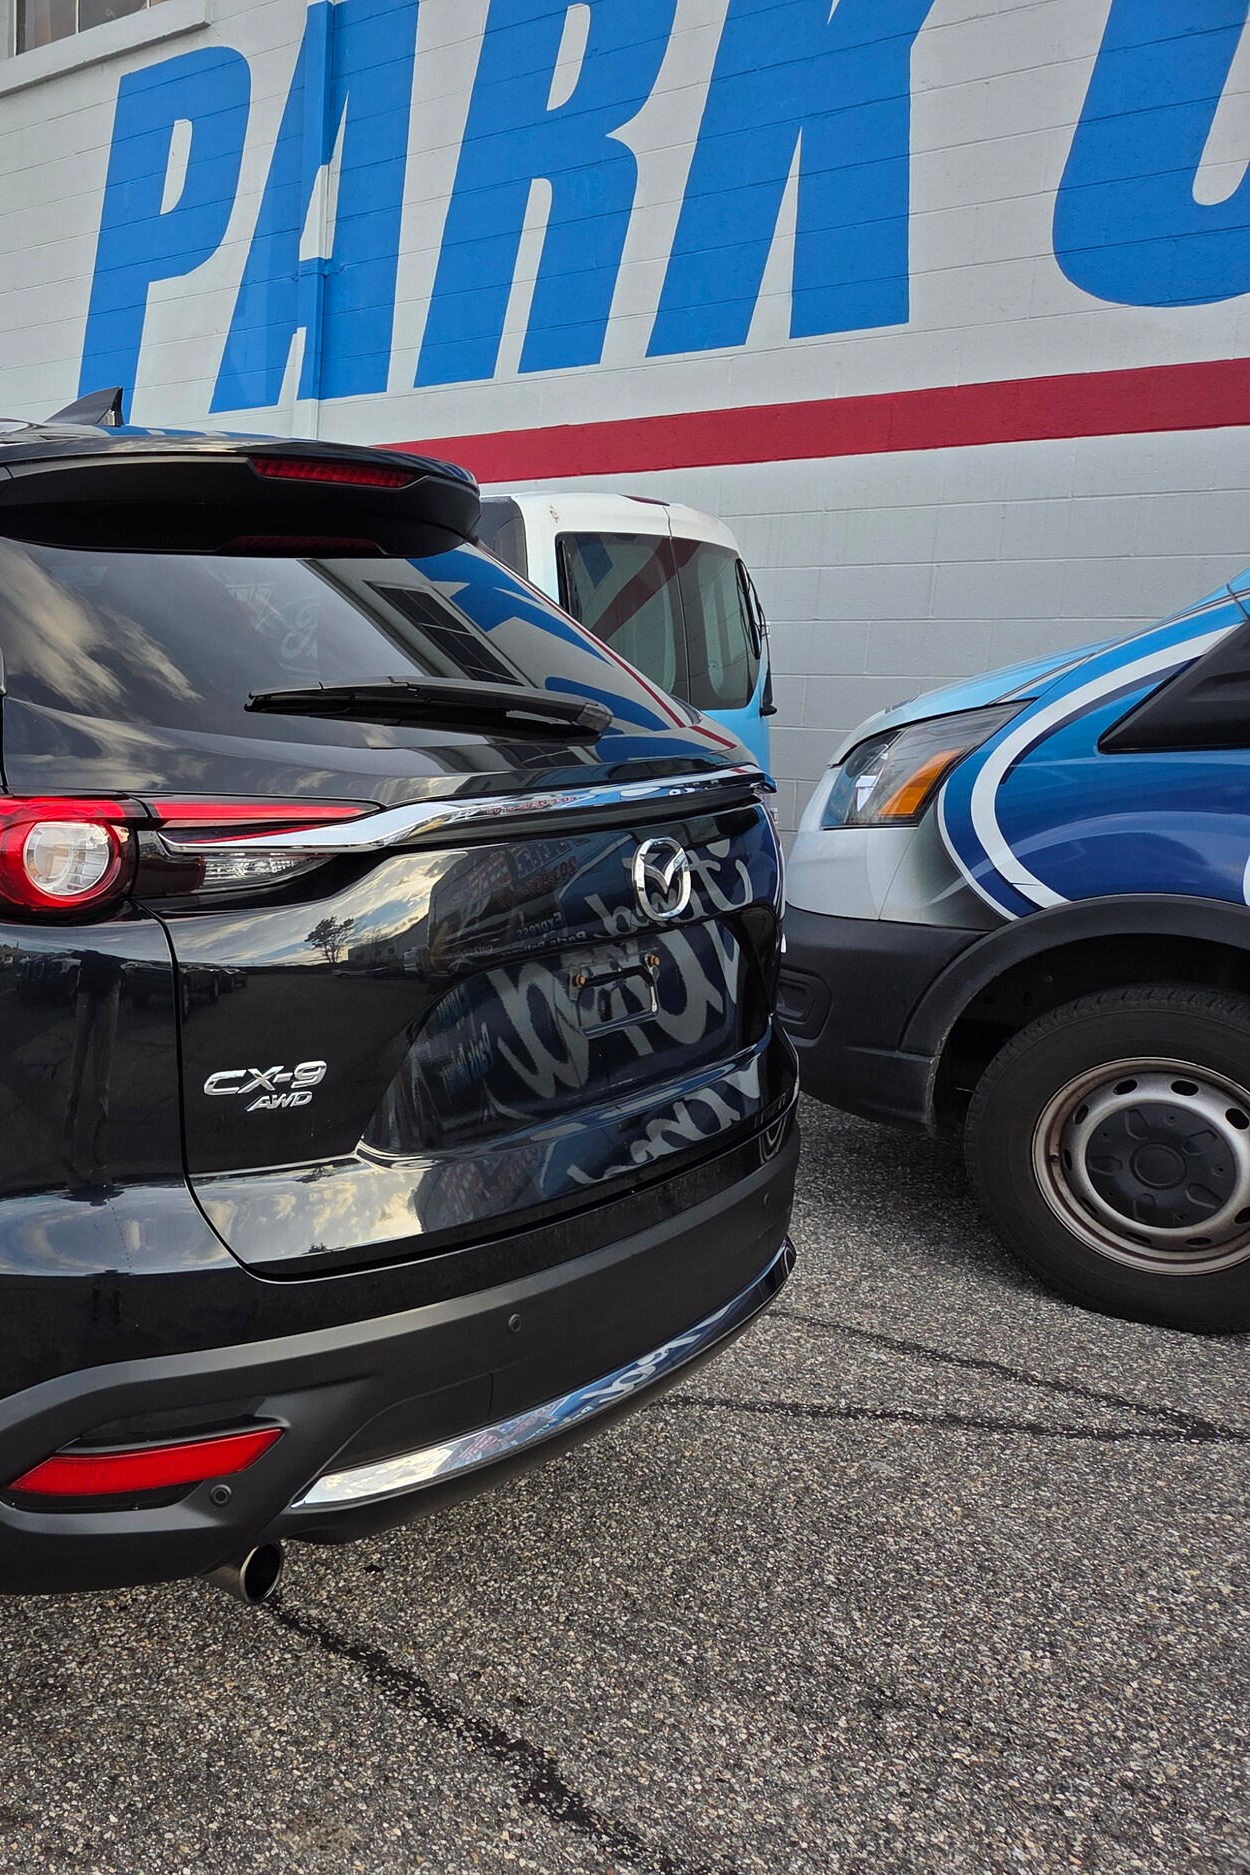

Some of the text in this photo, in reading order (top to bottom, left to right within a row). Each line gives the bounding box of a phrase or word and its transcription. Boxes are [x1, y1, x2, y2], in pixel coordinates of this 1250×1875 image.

[77, 0, 936, 425] PARK
[203, 1060, 327, 1095] CX-9
[245, 1091, 312, 1112] AWD
